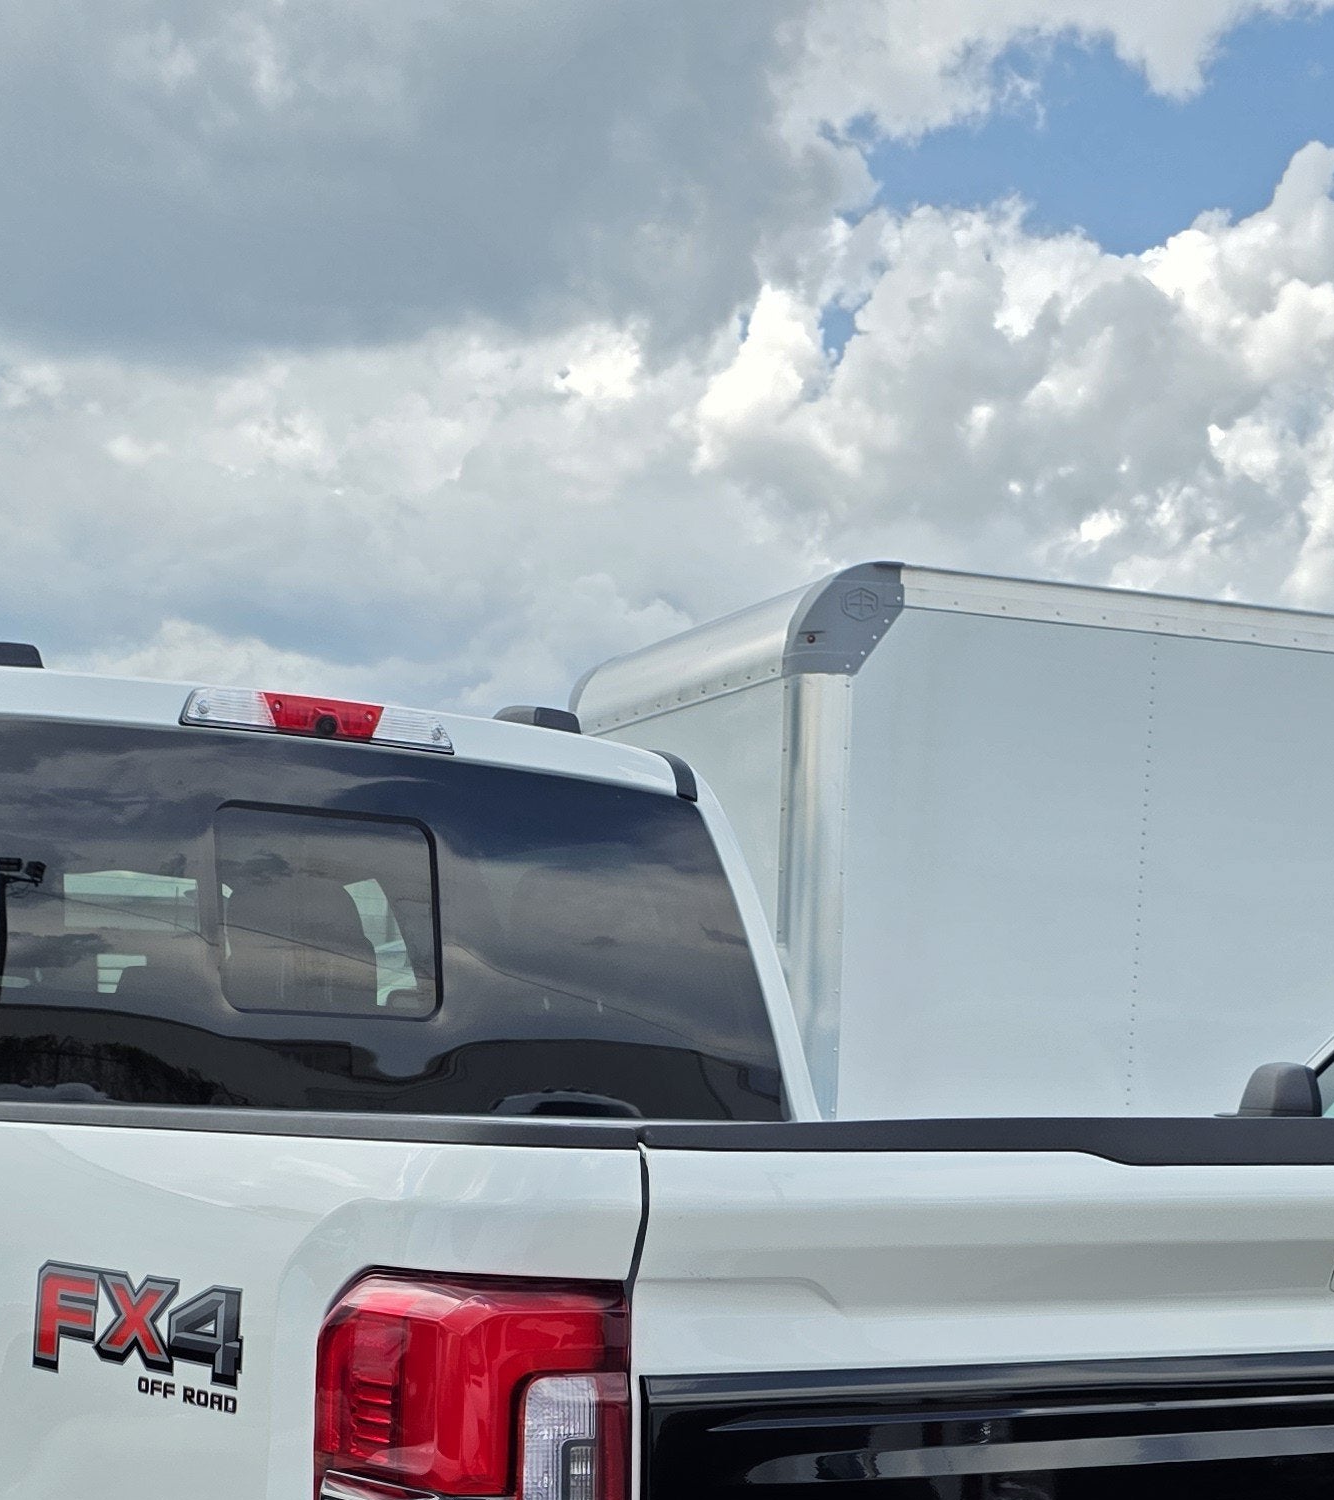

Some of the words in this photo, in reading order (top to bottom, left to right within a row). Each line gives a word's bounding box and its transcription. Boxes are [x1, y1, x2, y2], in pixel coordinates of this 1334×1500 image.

[32, 1259, 244, 1390] FX4
[137, 1375, 176, 1399] OFF
[182, 1385, 238, 1414] ROAD
